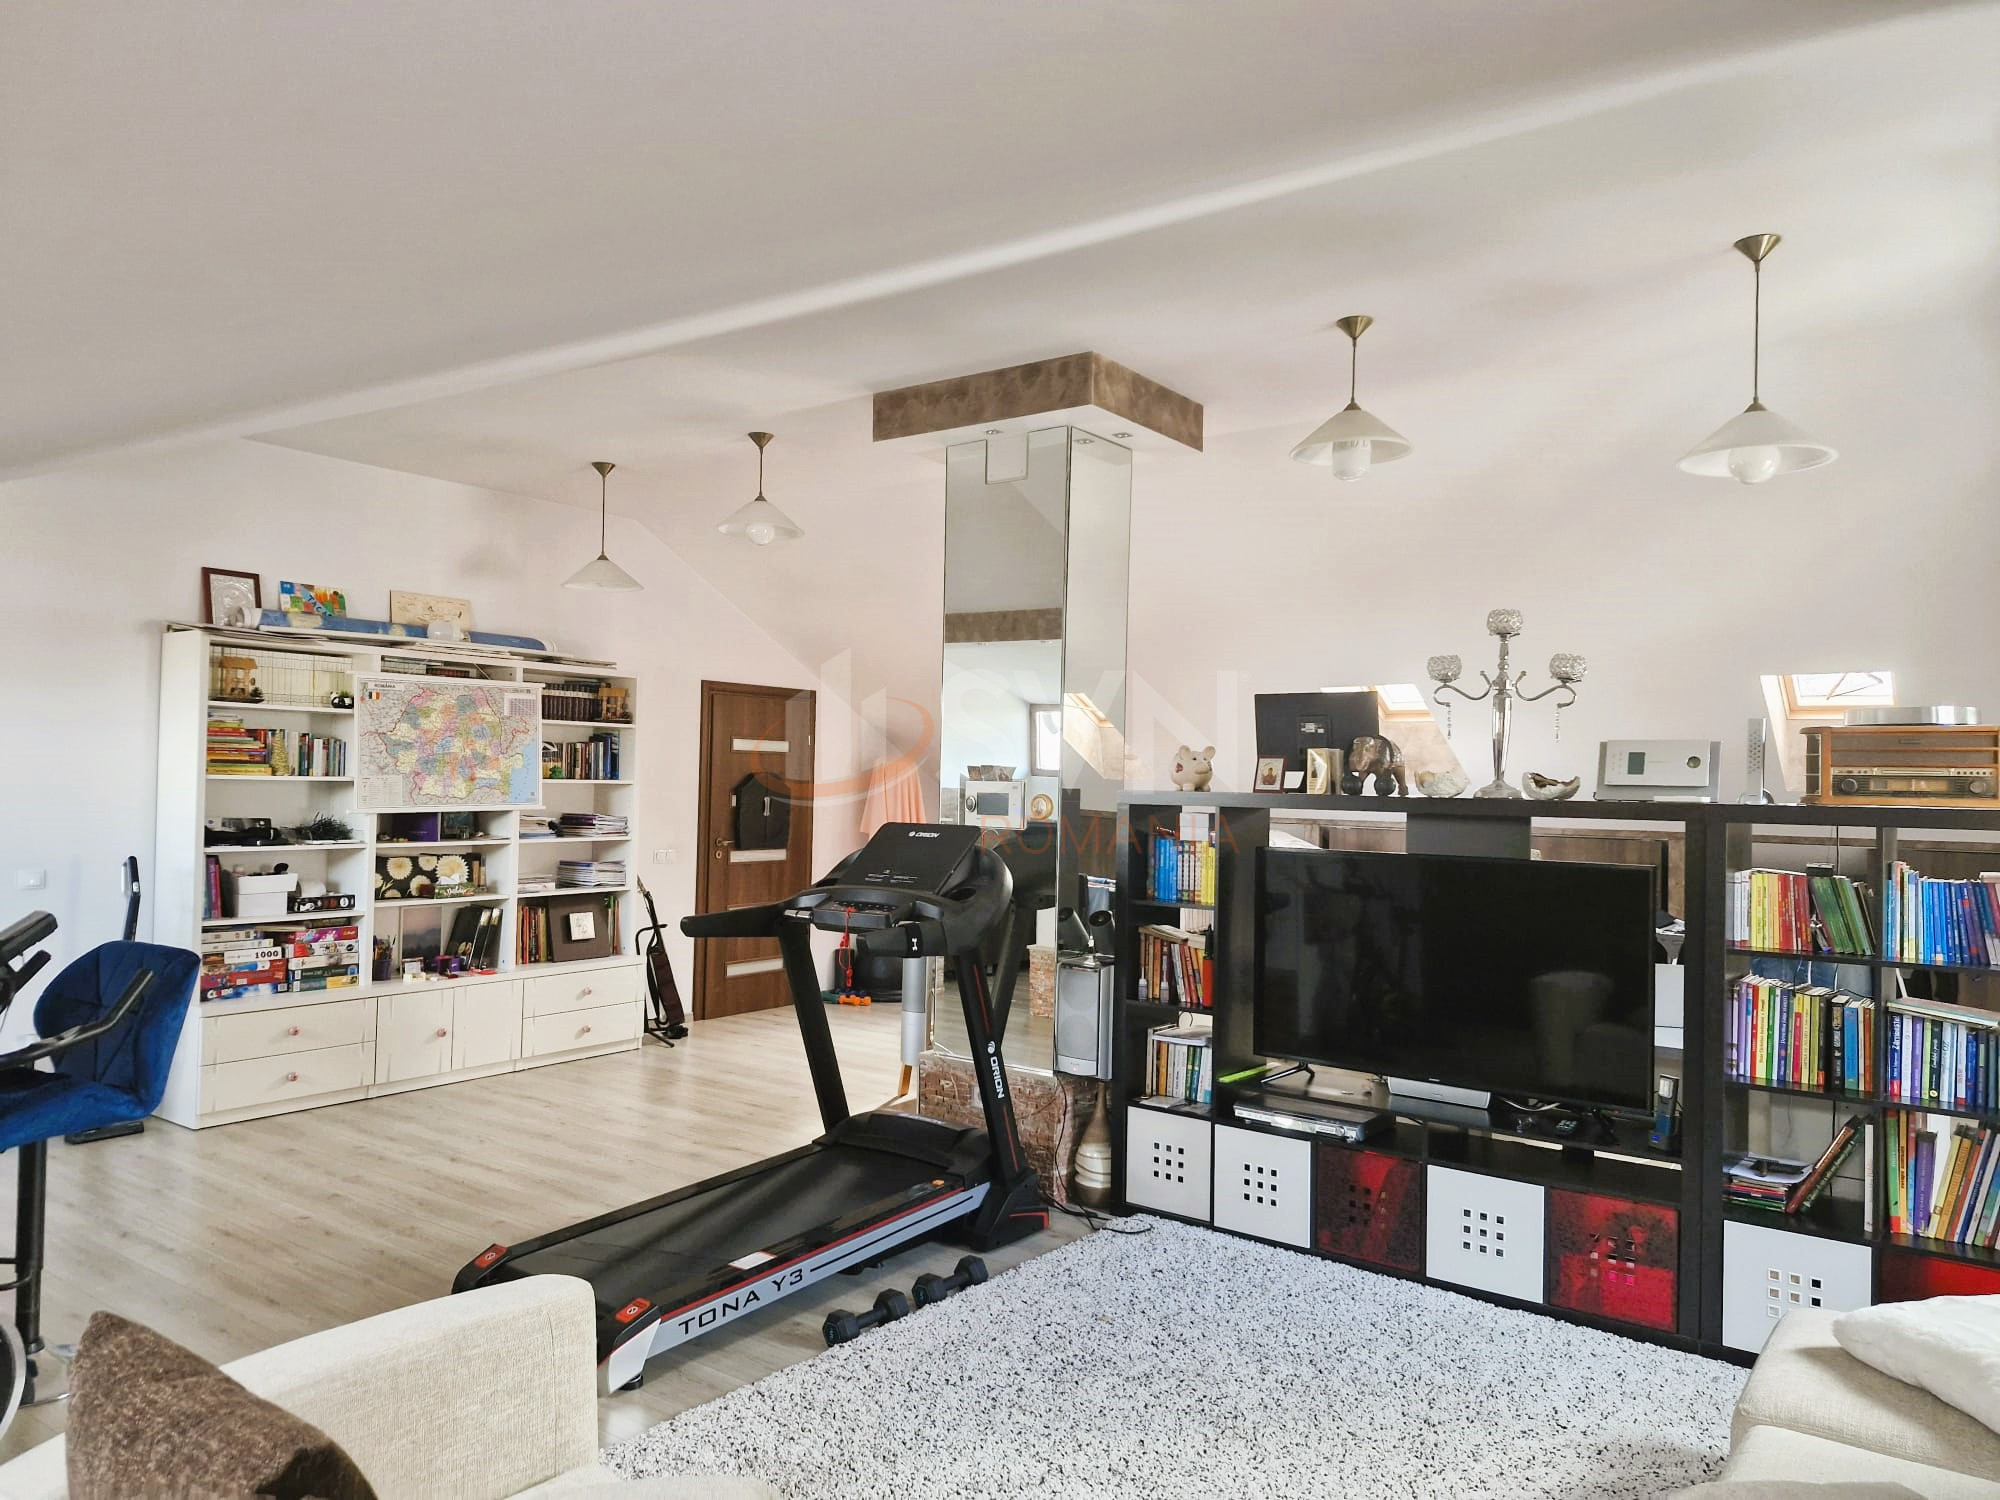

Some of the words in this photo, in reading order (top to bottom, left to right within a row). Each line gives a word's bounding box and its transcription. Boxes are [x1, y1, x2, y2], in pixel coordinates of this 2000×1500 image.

[254, 950, 279, 959] 1000
[990, 1056, 1005, 1099] ORION
[678, 1290, 760, 1335] TONA
[772, 1268, 803, 1292] Y3
